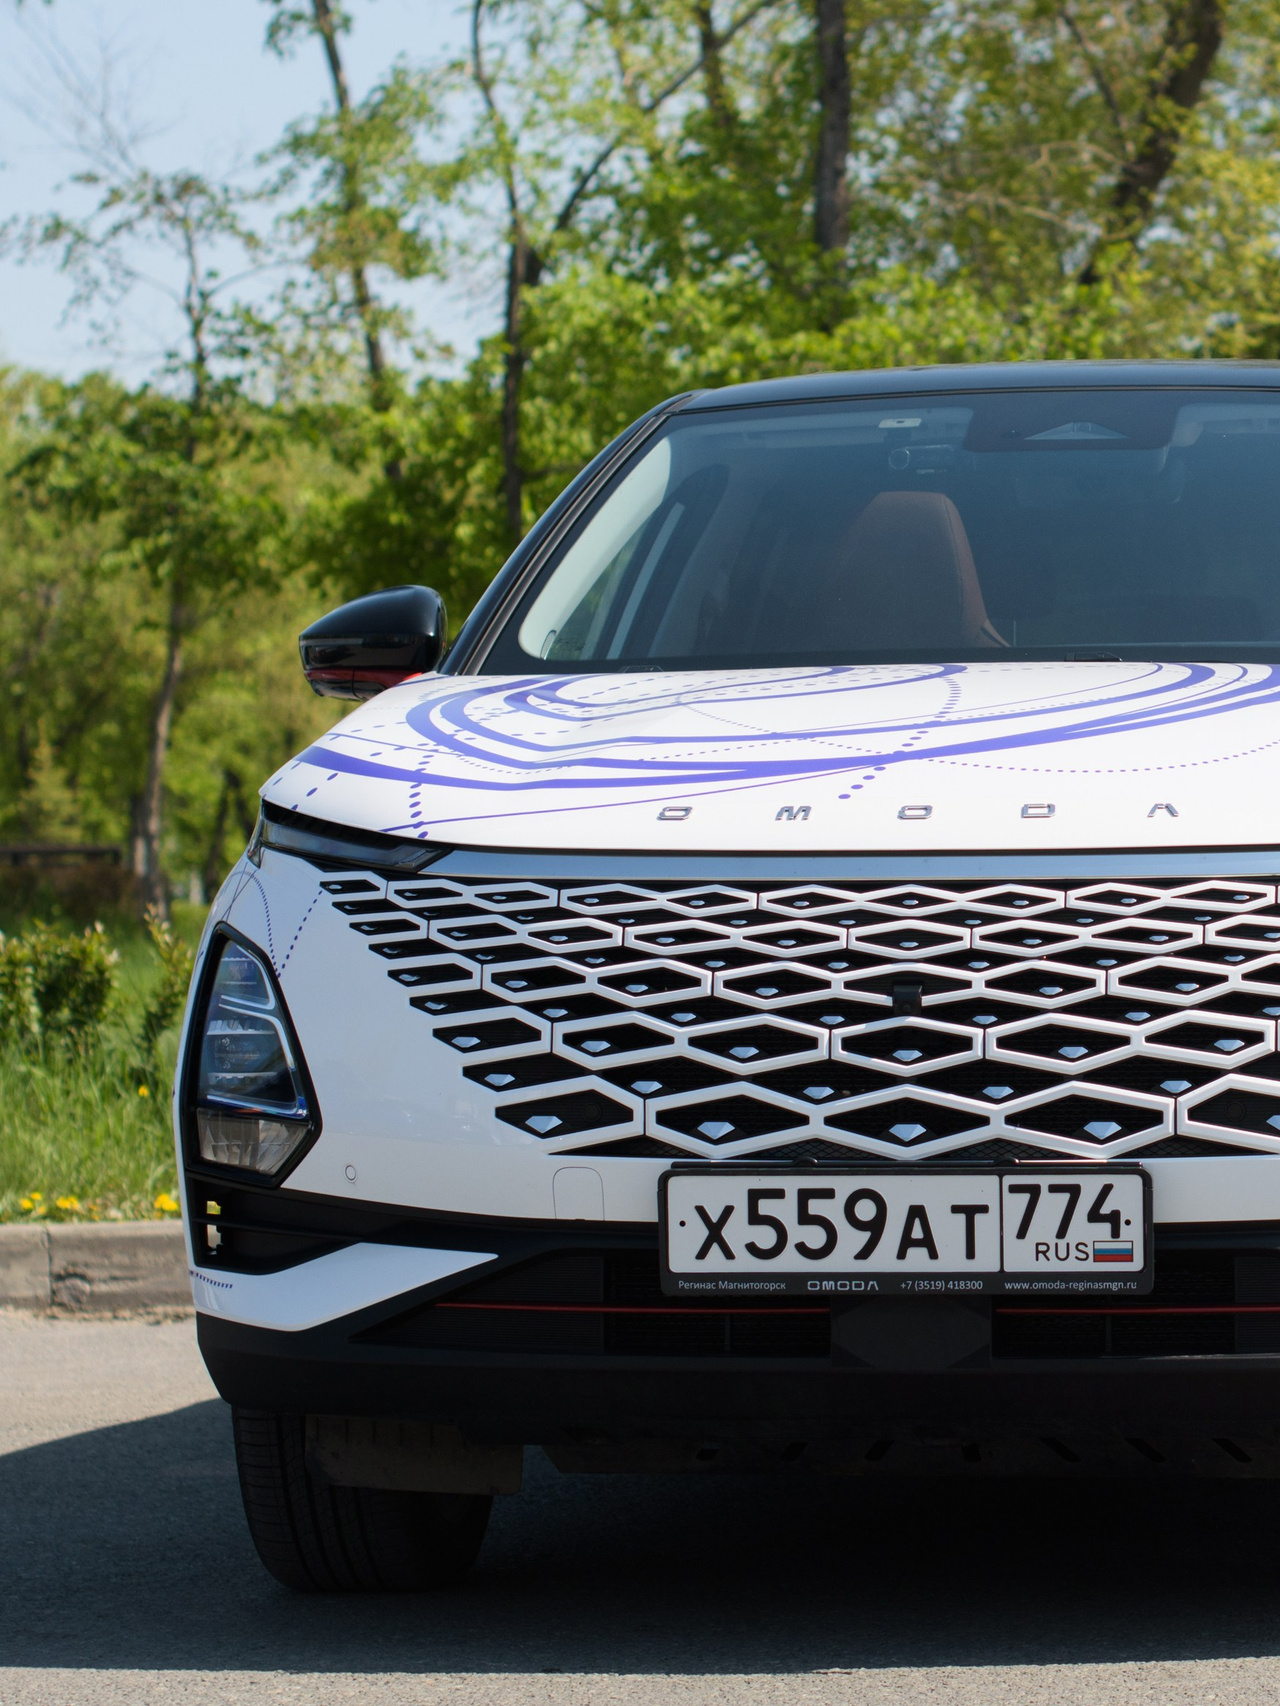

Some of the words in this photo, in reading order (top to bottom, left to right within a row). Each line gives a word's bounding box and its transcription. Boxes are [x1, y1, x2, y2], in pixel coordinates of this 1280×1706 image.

[657, 802, 1180, 821] OMODA
[1008, 1183, 1121, 1240] 774
[1035, 1241, 1090, 1262] RUS
[678, 1280, 717, 1293] Регинас
[718, 1280, 787, 1293] Магнитогорск
[807, 1280, 879, 1291] OMODA
[900, 1280, 913, 1291] +7
[914, 1280, 946, 1292] (3519)
[947, 1280, 984, 1291] 418300
[1004, 1280, 1138, 1292] www.omoda-reginasmgn.ru
